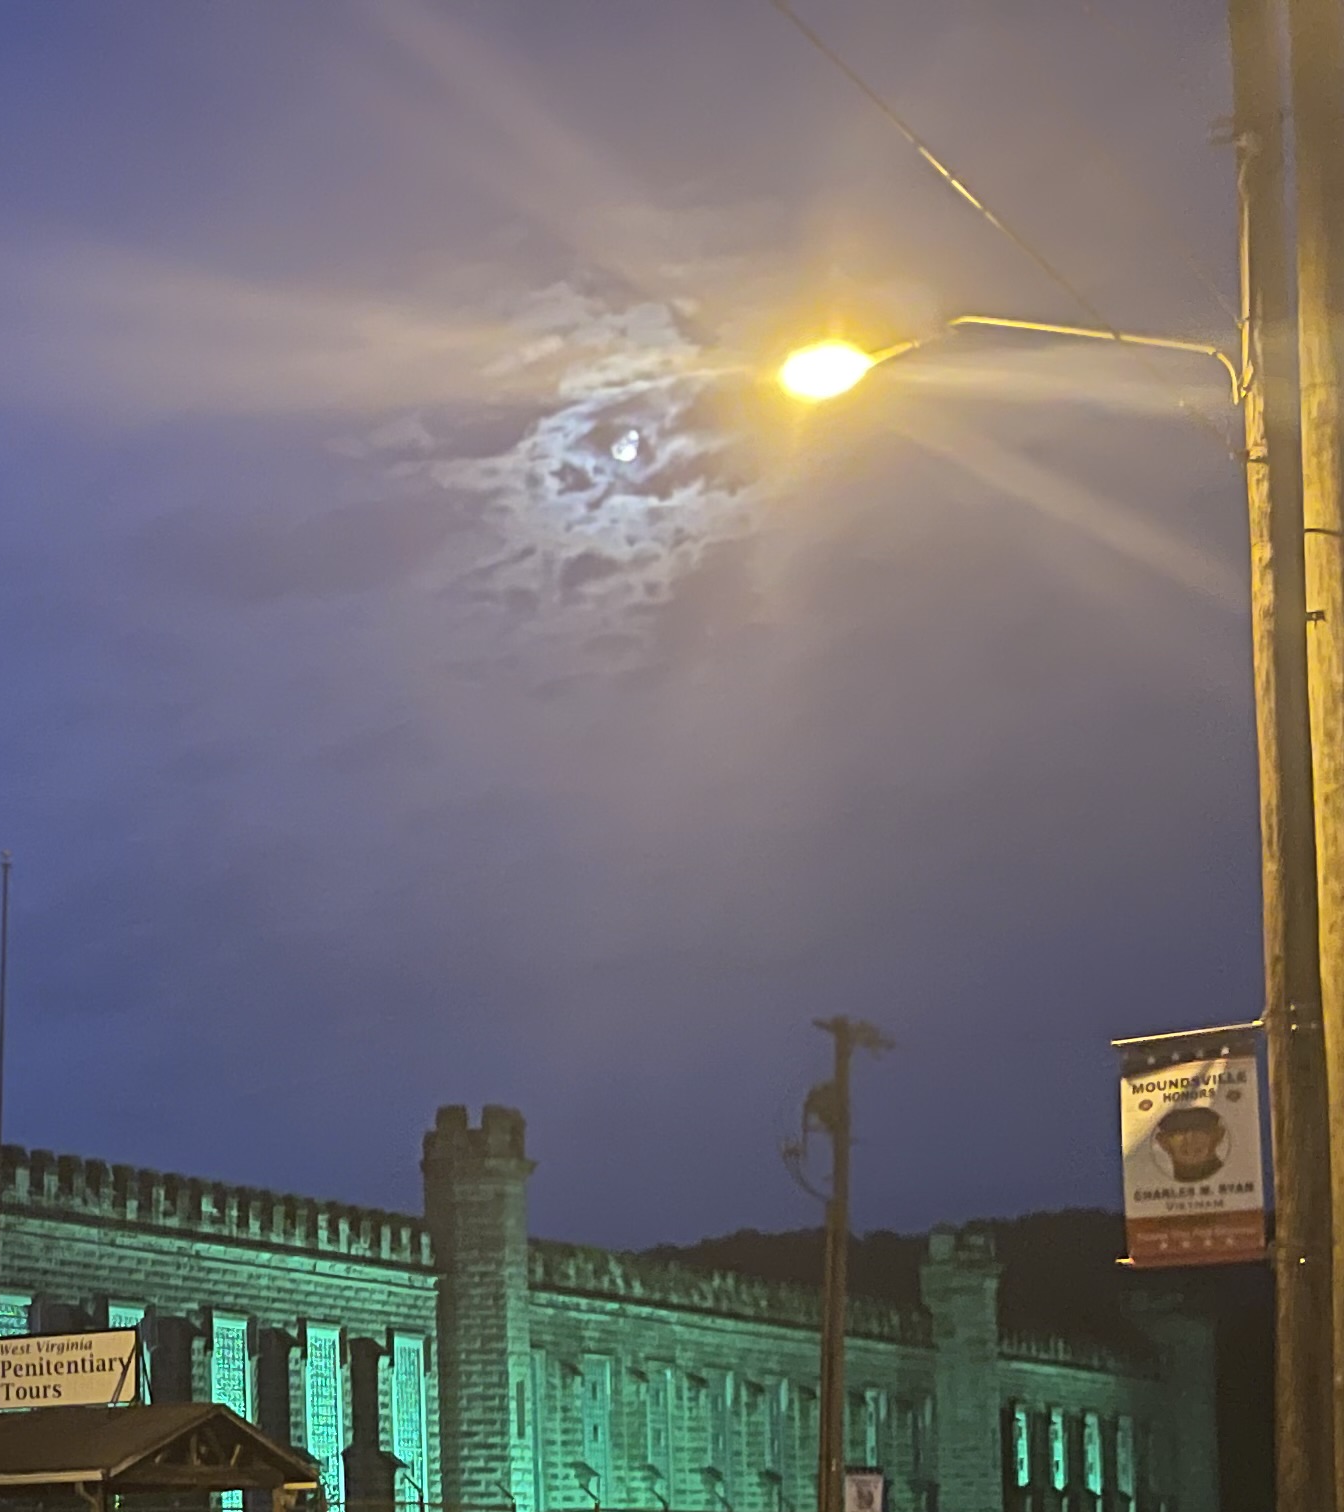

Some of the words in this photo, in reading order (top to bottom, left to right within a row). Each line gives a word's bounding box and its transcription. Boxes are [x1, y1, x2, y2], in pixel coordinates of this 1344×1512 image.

[1132, 1071, 1248, 1095] MOUNDSVILLE
[1163, 1088, 1216, 1103] HONORS
[0, 1342, 31, 1355] West
[36, 1337, 93, 1353] Virginia
[0, 1353, 130, 1379] Penitentiary
[0, 1383, 62, 1401] Tours
